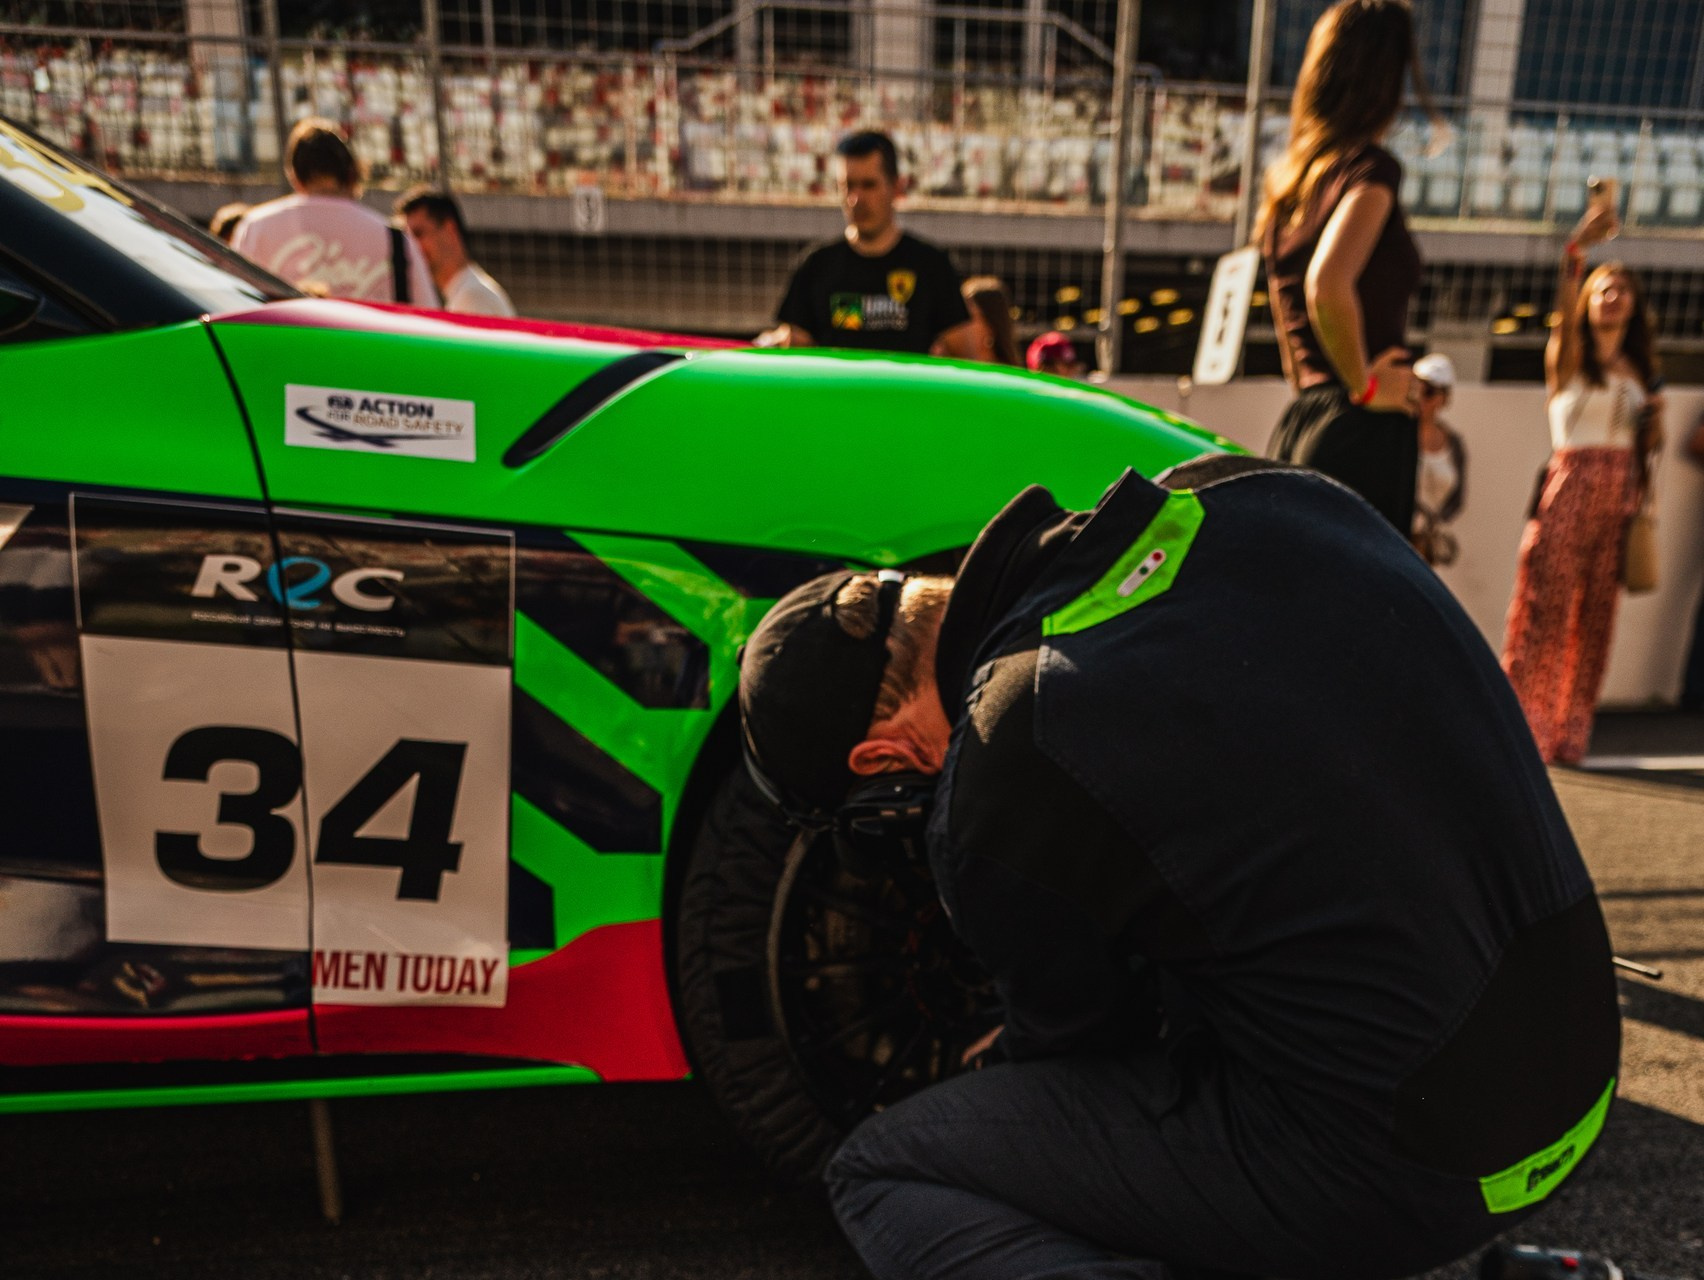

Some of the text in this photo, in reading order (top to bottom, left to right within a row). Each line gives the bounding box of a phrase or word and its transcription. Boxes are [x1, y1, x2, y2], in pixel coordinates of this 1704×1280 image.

[326, 410, 465, 434] FOR ROAD SAFETY
[359, 397, 434, 419] ACTION
[154, 724, 468, 903] 34
[311, 950, 499, 995] MEN TODAY
